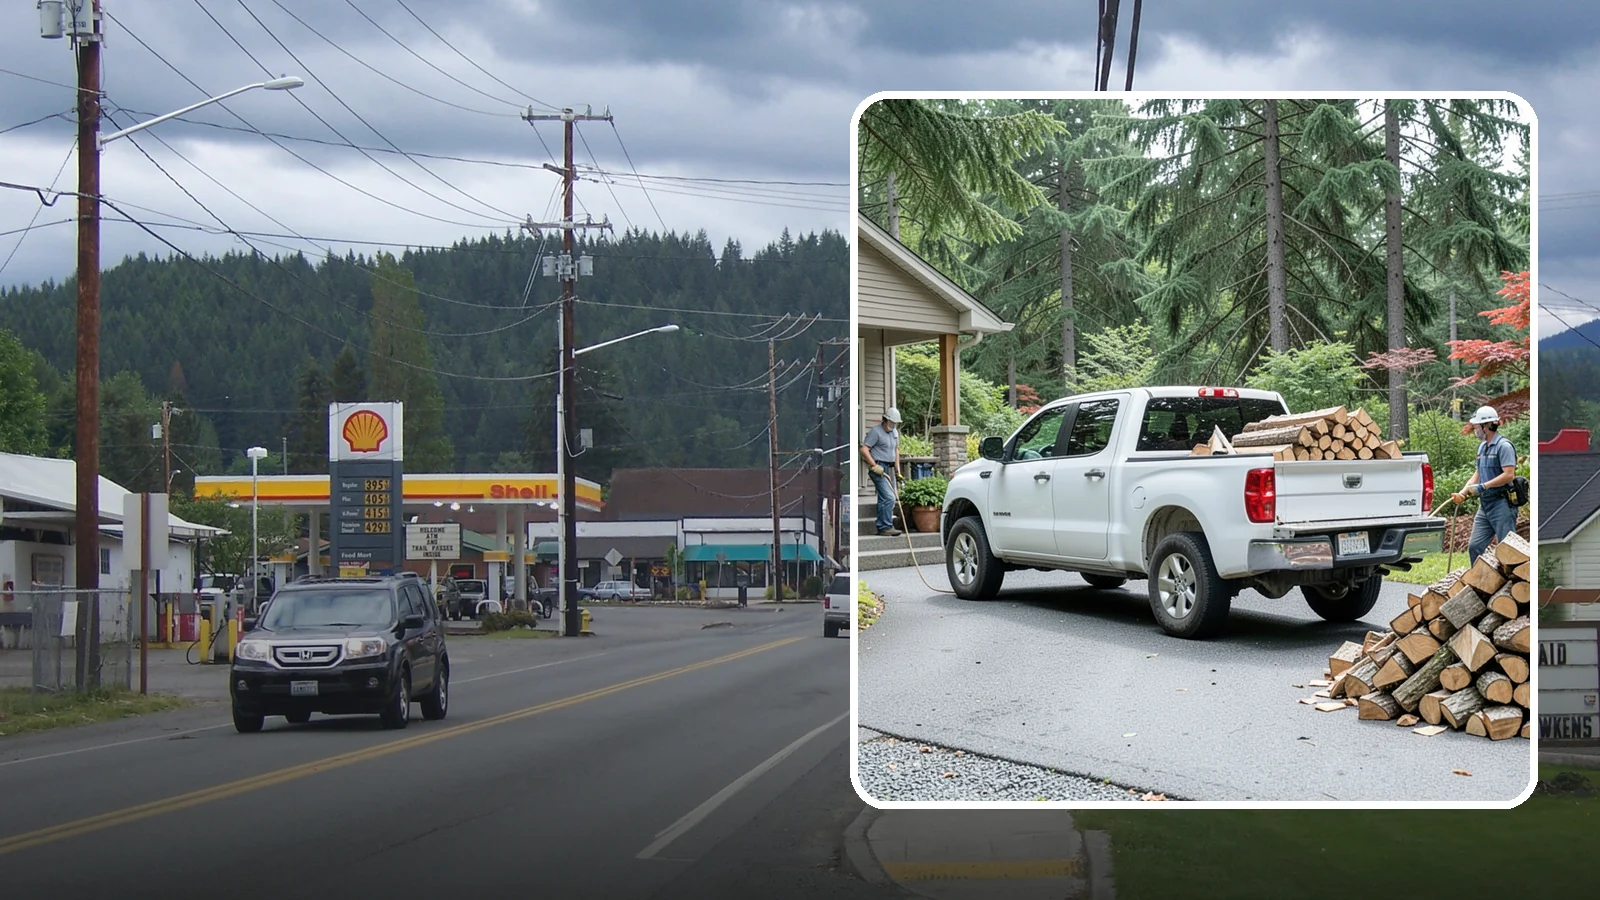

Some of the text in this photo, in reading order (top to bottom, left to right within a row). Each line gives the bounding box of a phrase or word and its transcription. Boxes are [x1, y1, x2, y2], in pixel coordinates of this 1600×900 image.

[366, 480, 384, 490] 395
[490, 484, 547, 499] Shell
[366, 494, 384, 504] 405
[366, 508, 384, 518] 415
[366, 522, 384, 532] 429
